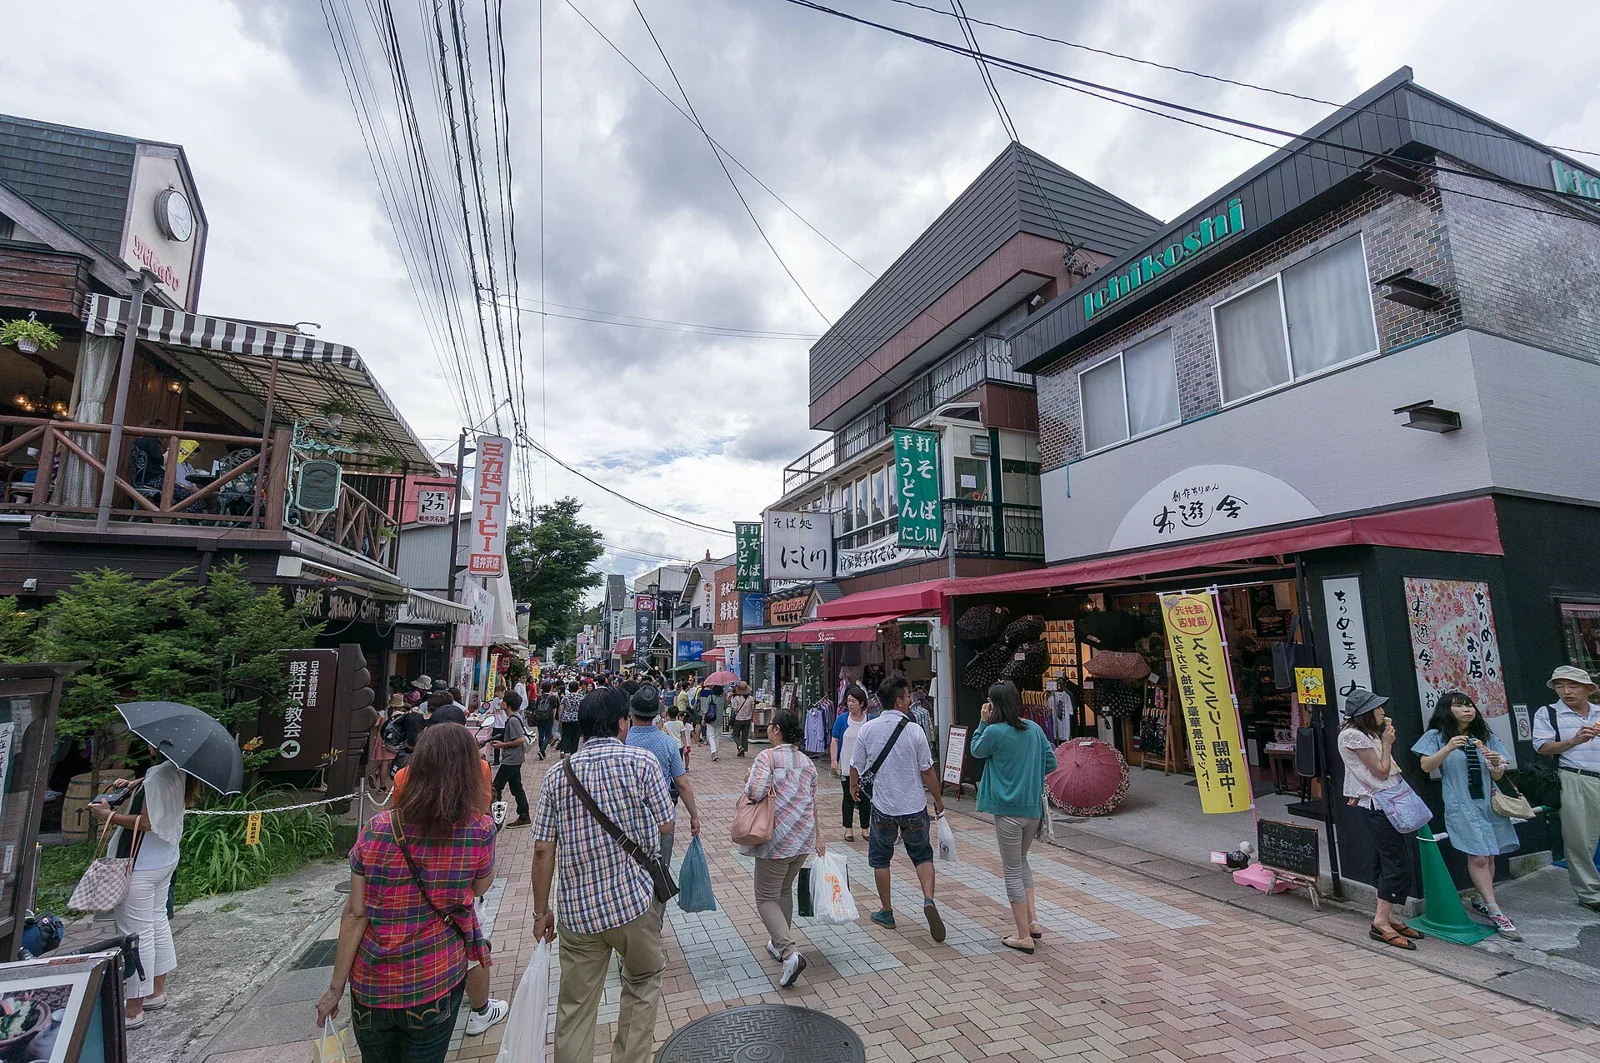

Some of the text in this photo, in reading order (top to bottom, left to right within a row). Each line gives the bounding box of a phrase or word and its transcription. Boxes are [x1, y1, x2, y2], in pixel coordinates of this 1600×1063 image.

[1084, 197, 1245, 321] Ichikoshi
[421, 491, 435, 513] ソフト
[434, 492, 446, 511] モカ
[478, 441, 504, 553] ミカドコーヒー
[1171, 483, 1220, 503] 創作ちりめん
[418, 515, 446, 523] 軽井沢名物
[773, 517, 813, 530] そば処
[901, 526, 938, 543] にし川
[472, 555, 500, 570] 軽井沢店
[780, 545, 828, 572] にし川
[737, 580, 760, 590] にし川
[296, 585, 324, 617] 軽沢
[1334, 589, 1361, 670] ちりめん工房
[1474, 591, 1497, 679] ちりめんの
[1466, 635, 1484, 680] お店
[306, 660, 320, 707] 日本基督教団
[283, 660, 308, 738] 軽井沢教会
